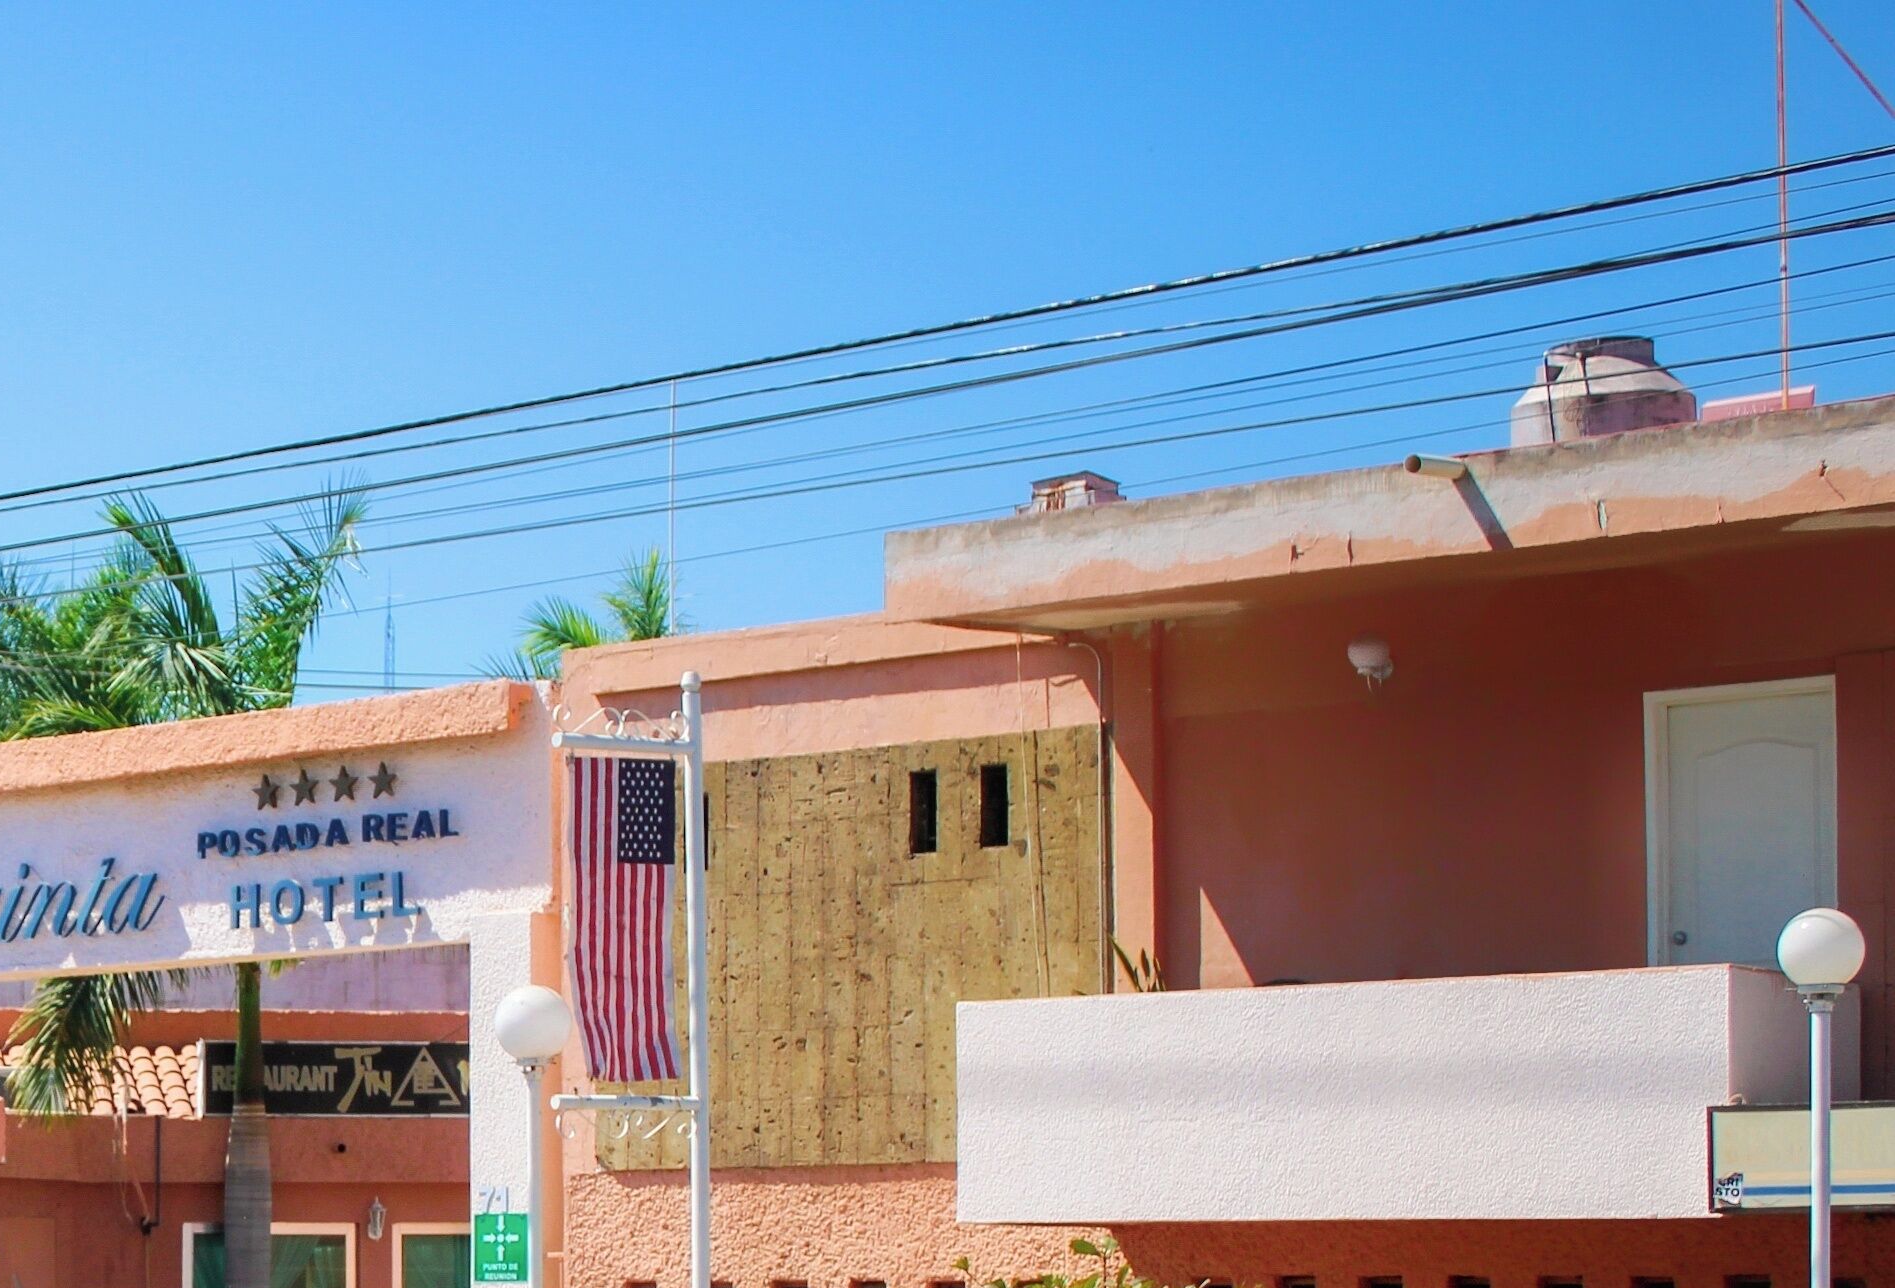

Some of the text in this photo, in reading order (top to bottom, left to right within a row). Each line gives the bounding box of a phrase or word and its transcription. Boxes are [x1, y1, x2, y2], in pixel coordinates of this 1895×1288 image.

[197, 809, 459, 859] POSADA REAL
[230, 871, 422, 929] HOTEL
[212, 1065, 338, 1092] REAURANT
